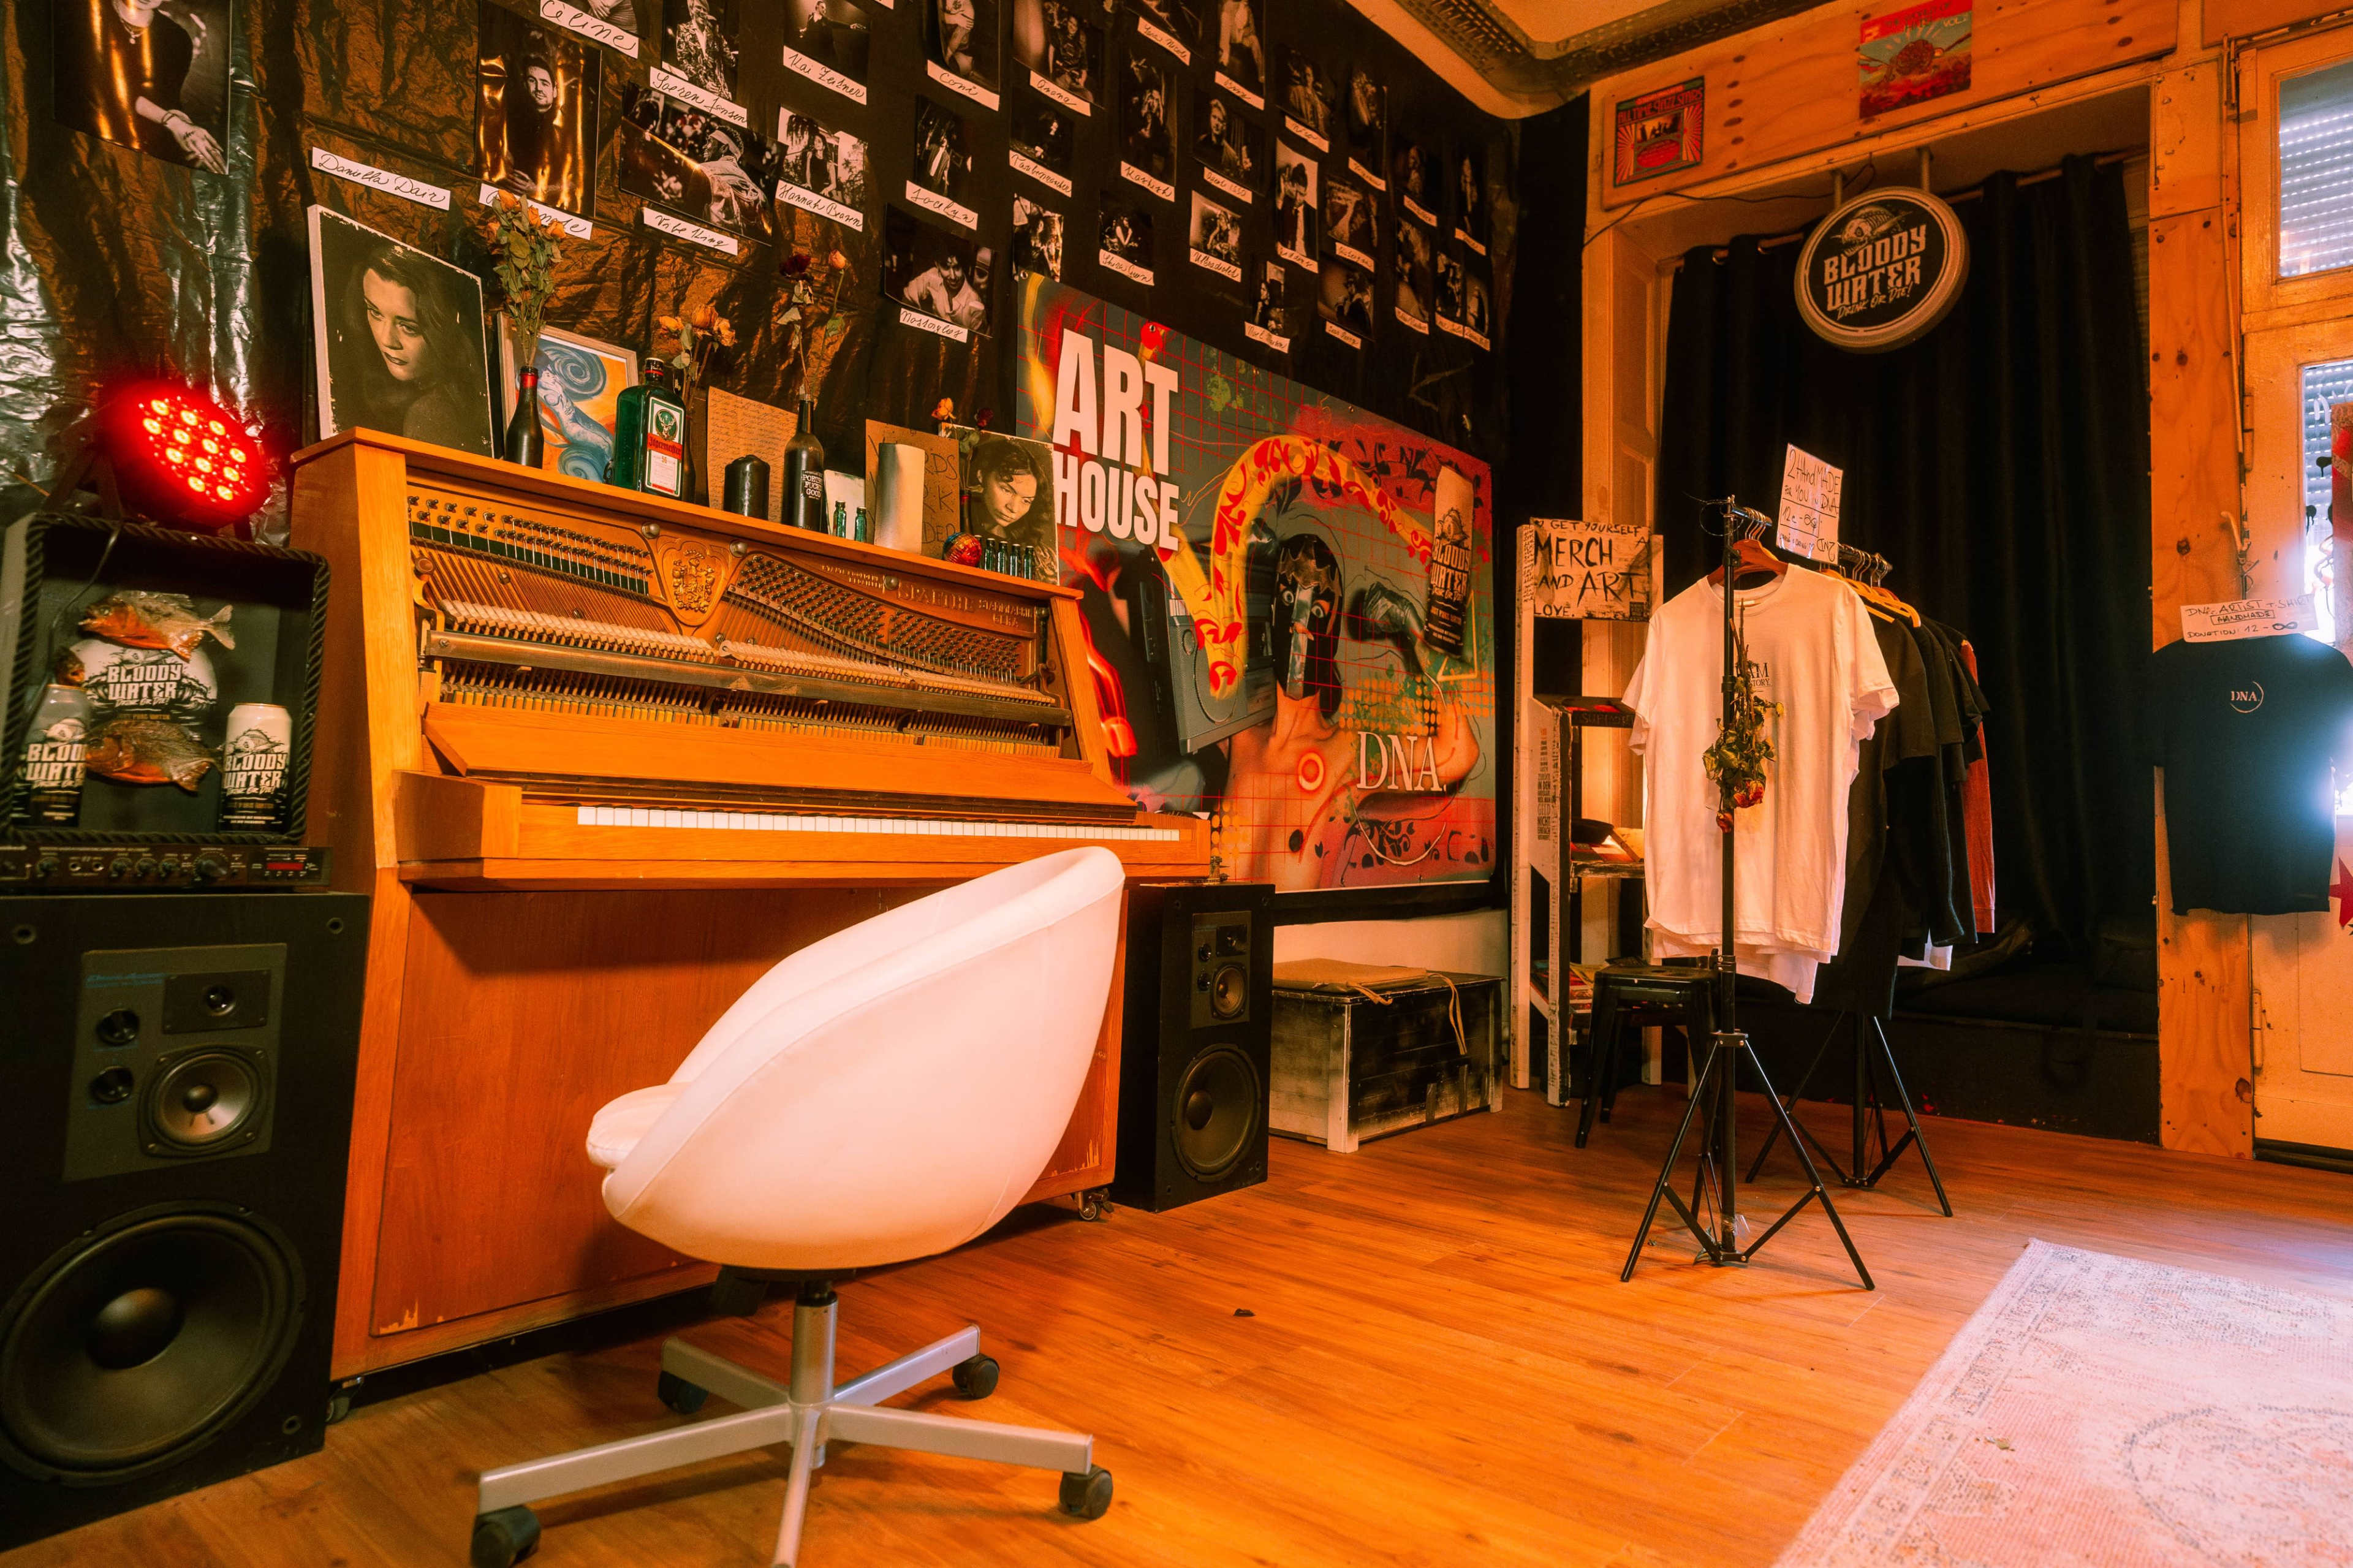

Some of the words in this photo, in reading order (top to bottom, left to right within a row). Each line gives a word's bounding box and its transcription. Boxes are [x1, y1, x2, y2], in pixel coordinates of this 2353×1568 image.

[318, 153, 390, 186] Daniella
[778, 183, 827, 211] Hannah
[1824, 224, 1927, 286] BLOODY
[1826, 255, 1921, 311] WATER
[1052, 327, 1178, 476] ART
[1053, 449, 1180, 552] HOUSE
[1550, 520, 1580, 531] GET
[1585, 521, 1643, 537] YOURSELF
[1533, 529, 1613, 569] MERCH
[1537, 574, 1574, 590] AND
[1577, 570, 1647, 608] ART
[2217, 611, 2271, 623] HANDMADE
[2219, 599, 2263, 614] ARTIST
[107, 664, 183, 683] BLOODY
[108, 681, 178, 701] WATER
[27, 743, 87, 761] BLOO
[225, 754, 287, 772] BLOODY
[223, 770, 282, 789] WATER
